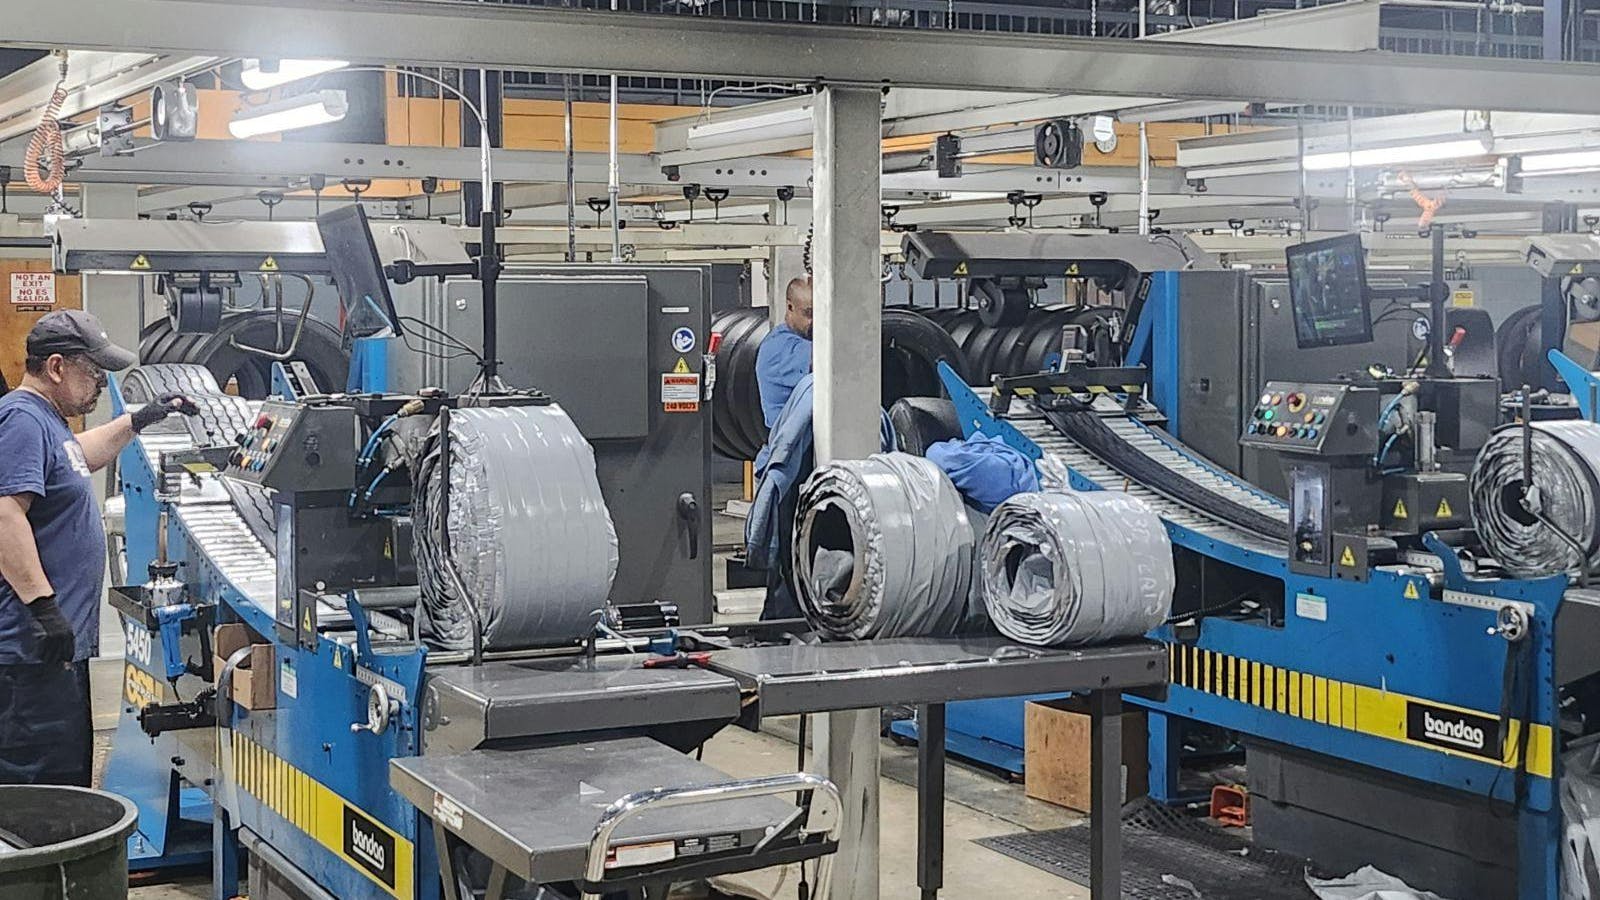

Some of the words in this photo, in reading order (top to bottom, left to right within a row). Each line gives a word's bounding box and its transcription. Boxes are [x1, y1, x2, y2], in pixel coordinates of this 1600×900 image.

[19, 288, 33, 296] NO
[35, 288, 48, 296] ES
[127, 622, 152, 667] 5450
[1424, 711, 1484, 749] bandag
[352, 819, 385, 870] bandag
